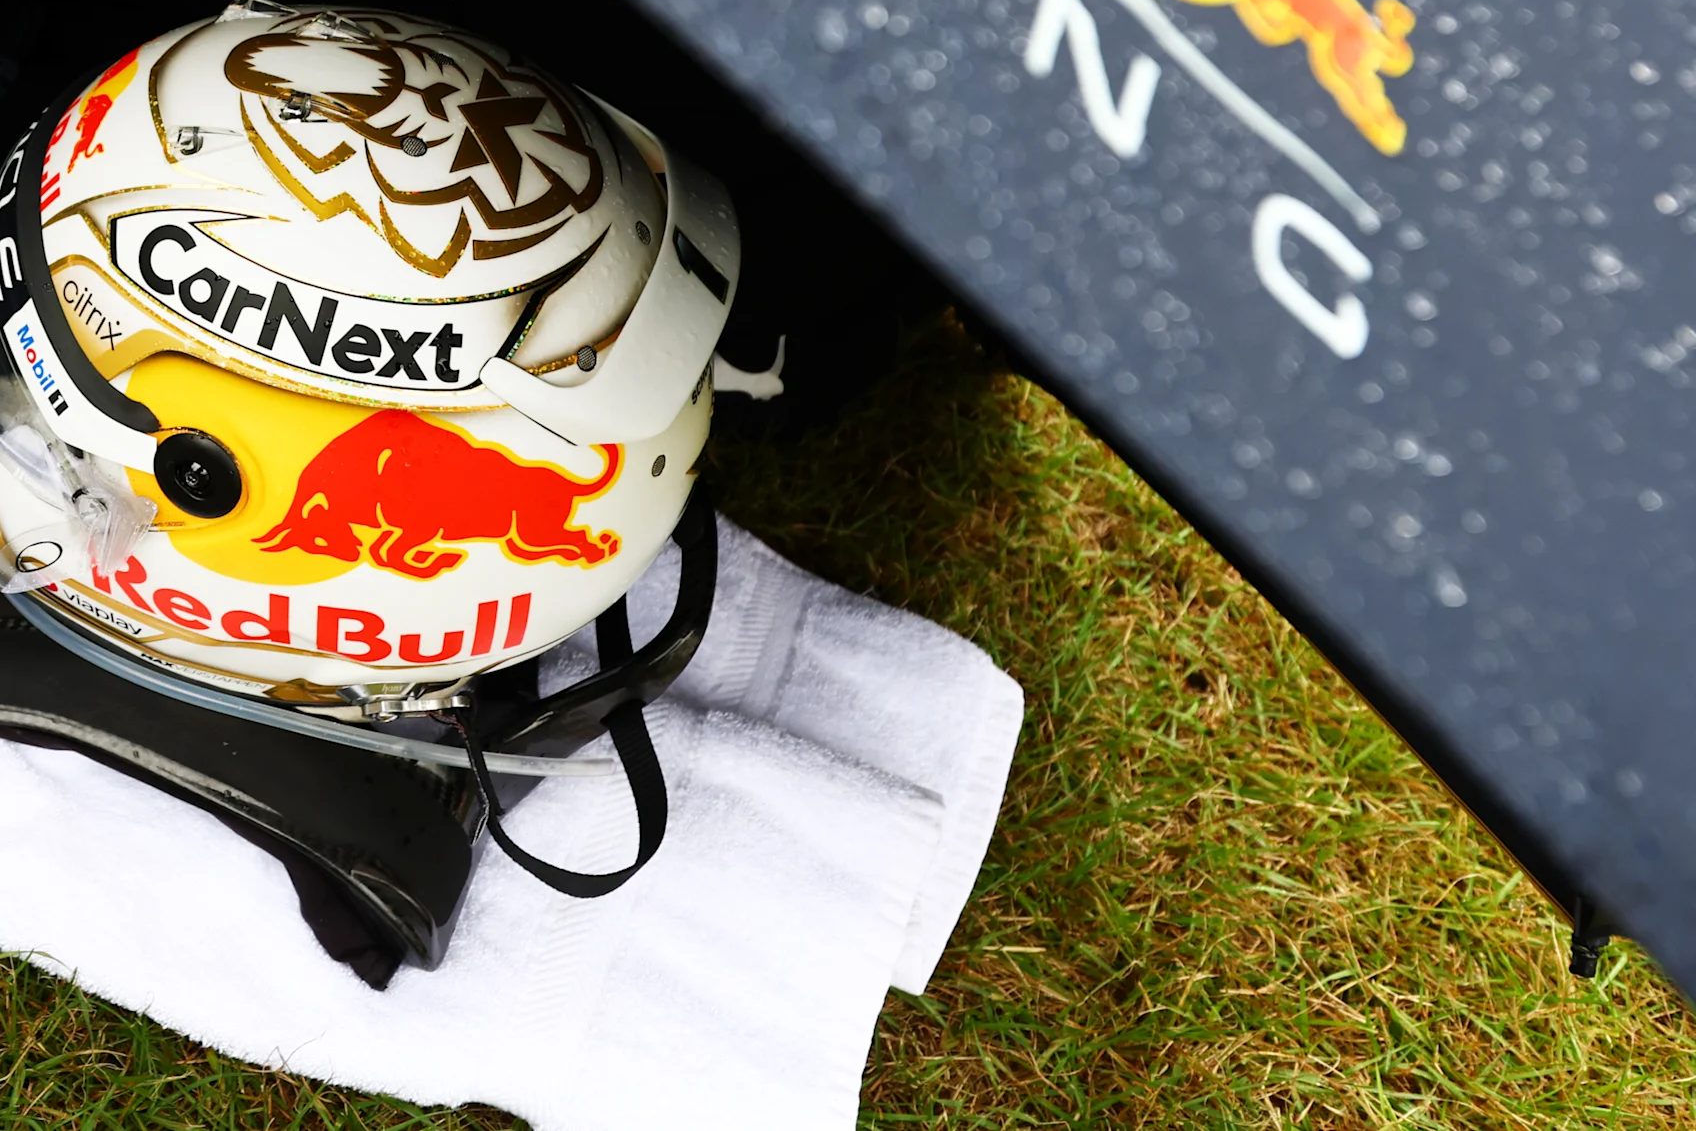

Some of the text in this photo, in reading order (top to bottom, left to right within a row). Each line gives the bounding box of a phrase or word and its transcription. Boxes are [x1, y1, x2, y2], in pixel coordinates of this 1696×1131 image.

[62, 280, 123, 351] citrix
[139, 224, 464, 383] CarNext
[17, 324, 69, 416] Mobil 1
[62, 588, 143, 636] viaplay
[89, 534, 533, 664] Red Bull
